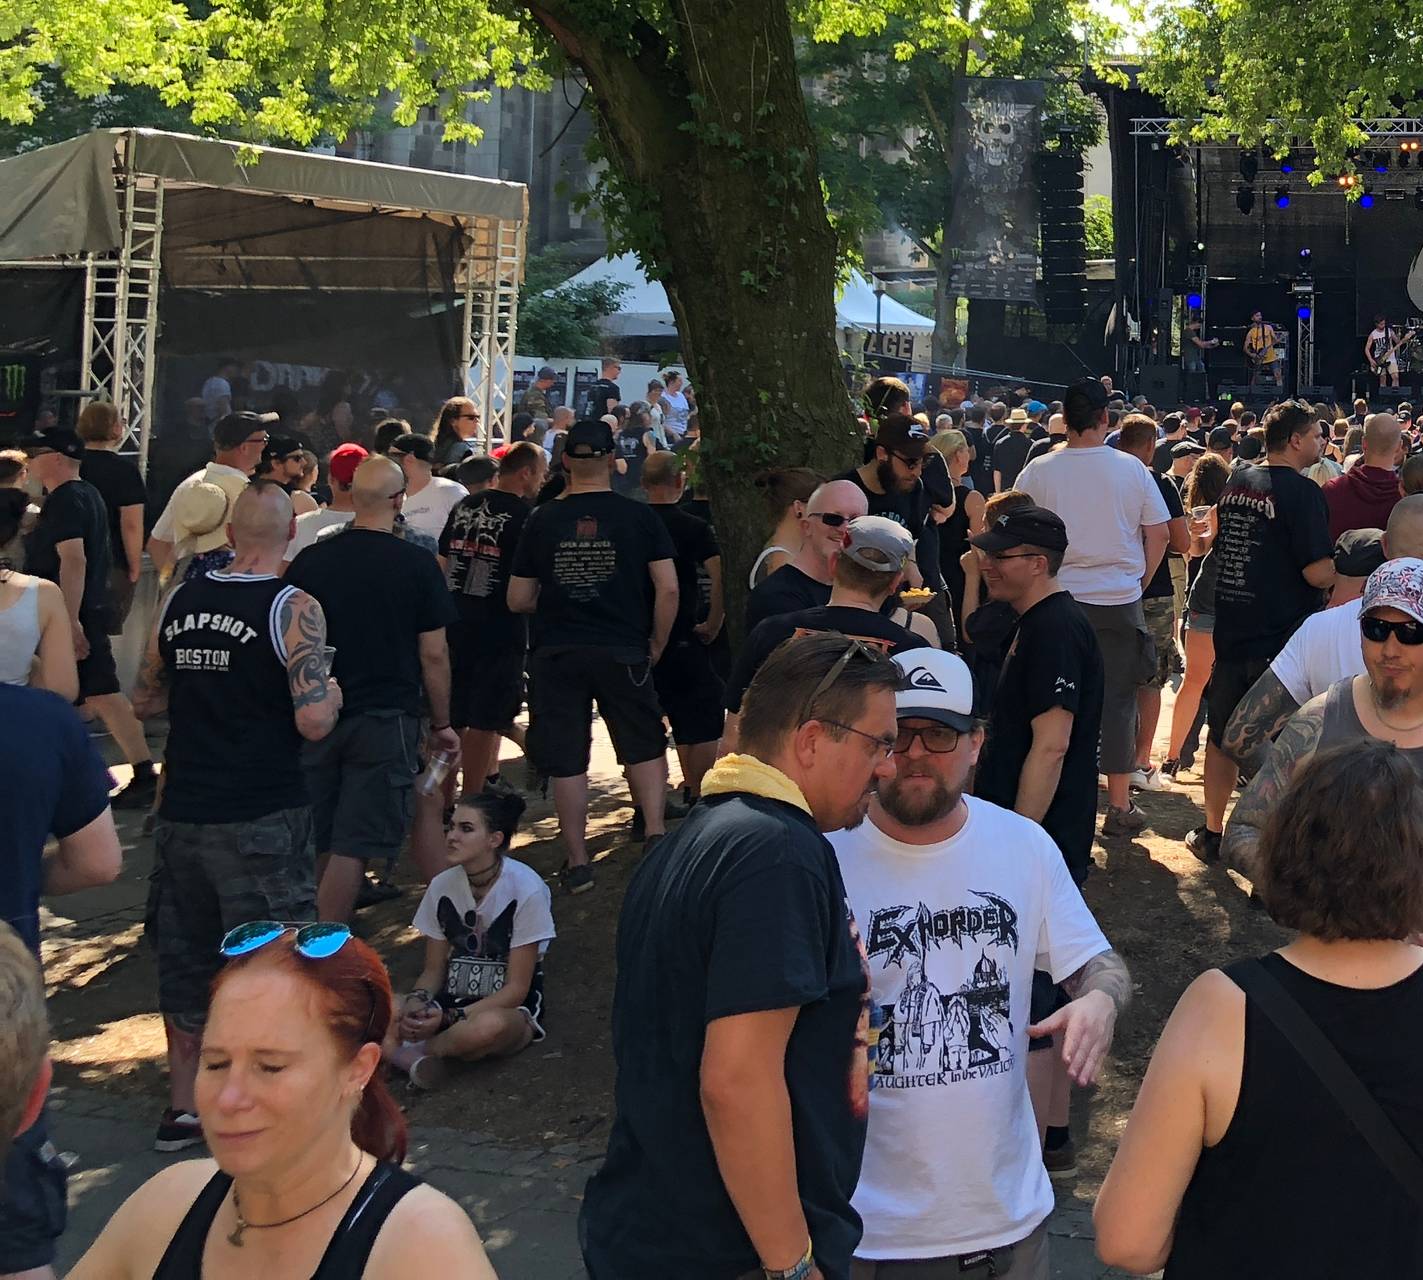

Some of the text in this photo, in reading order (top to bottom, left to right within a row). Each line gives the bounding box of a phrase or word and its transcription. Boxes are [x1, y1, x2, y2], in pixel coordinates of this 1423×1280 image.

[165, 612, 258, 644] SLAPSHOT
[175, 648, 230, 667] BOSTON
[875, 1071, 949, 1090] AUGHTER
